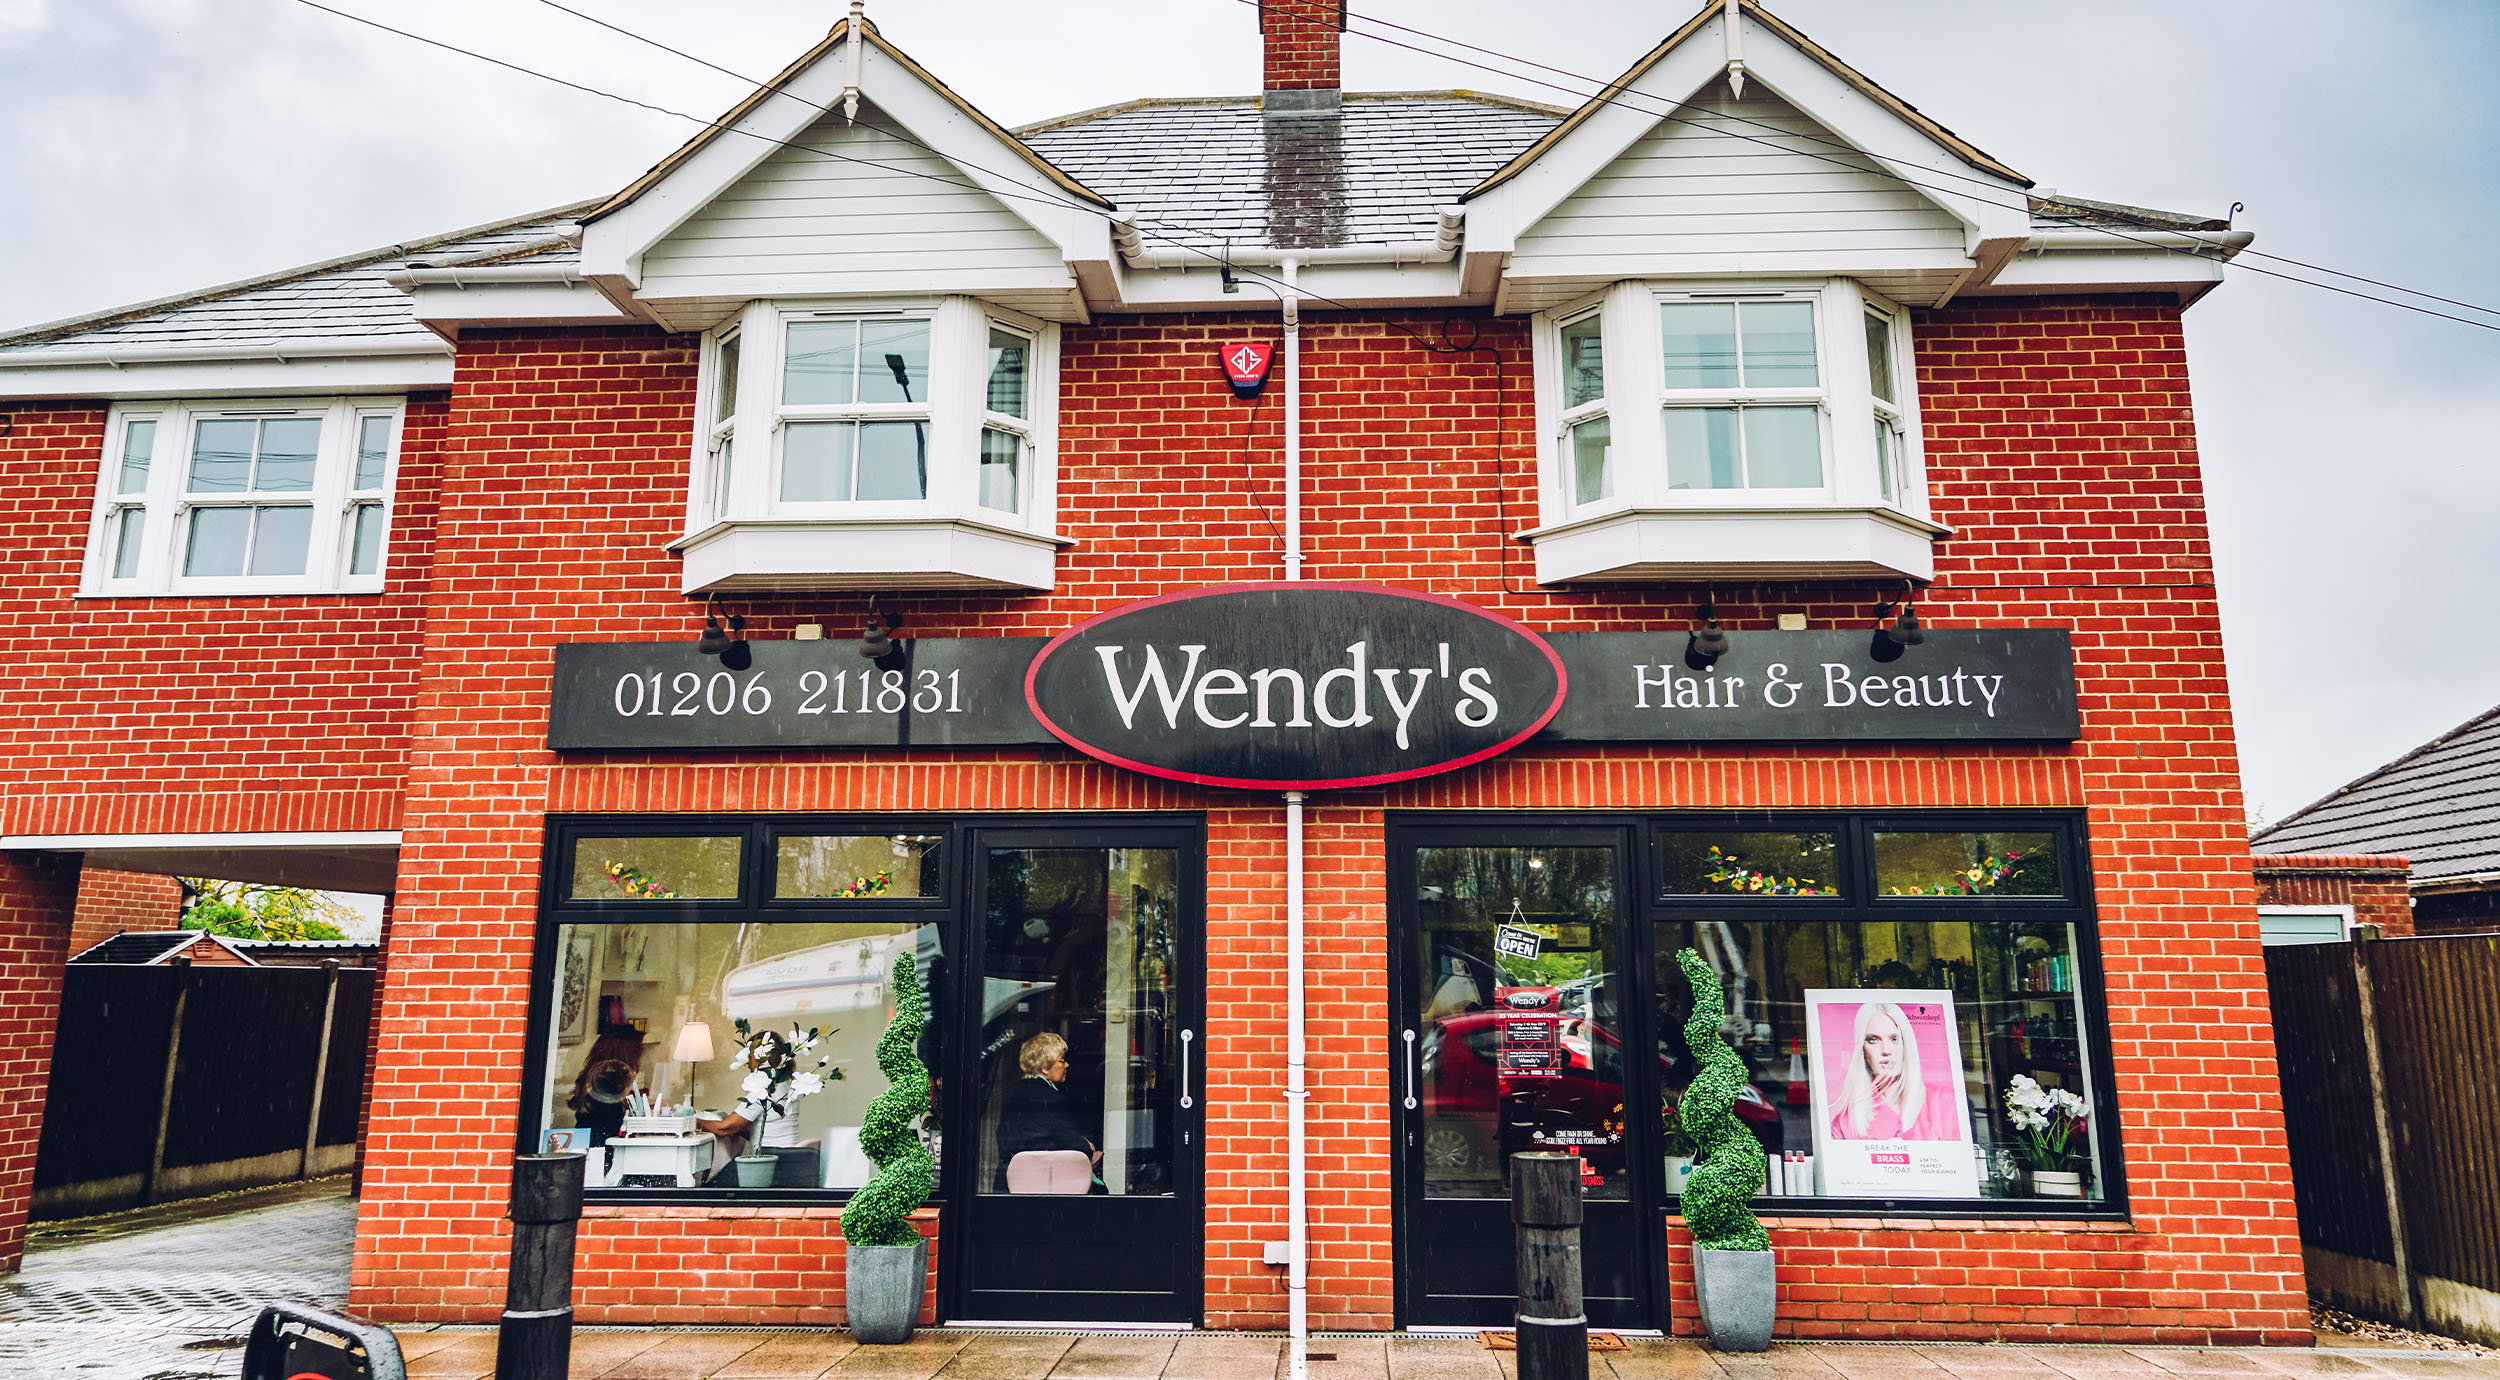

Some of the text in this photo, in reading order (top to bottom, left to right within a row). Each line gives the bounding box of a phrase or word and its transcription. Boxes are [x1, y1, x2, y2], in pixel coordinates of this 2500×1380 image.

[615, 668, 963, 717] 01206 211831
[1095, 641, 1498, 749] Wendy's
[1633, 664, 2003, 718] Hair & Beauty
[1500, 938, 1534, 957] OPEN
[1509, 996, 1546, 1006] Wendy's
[1864, 1144, 1909, 1152] BREAK THE
[1876, 1155, 1905, 1163] BRASS
[1883, 1166, 1911, 1174] TODAY
